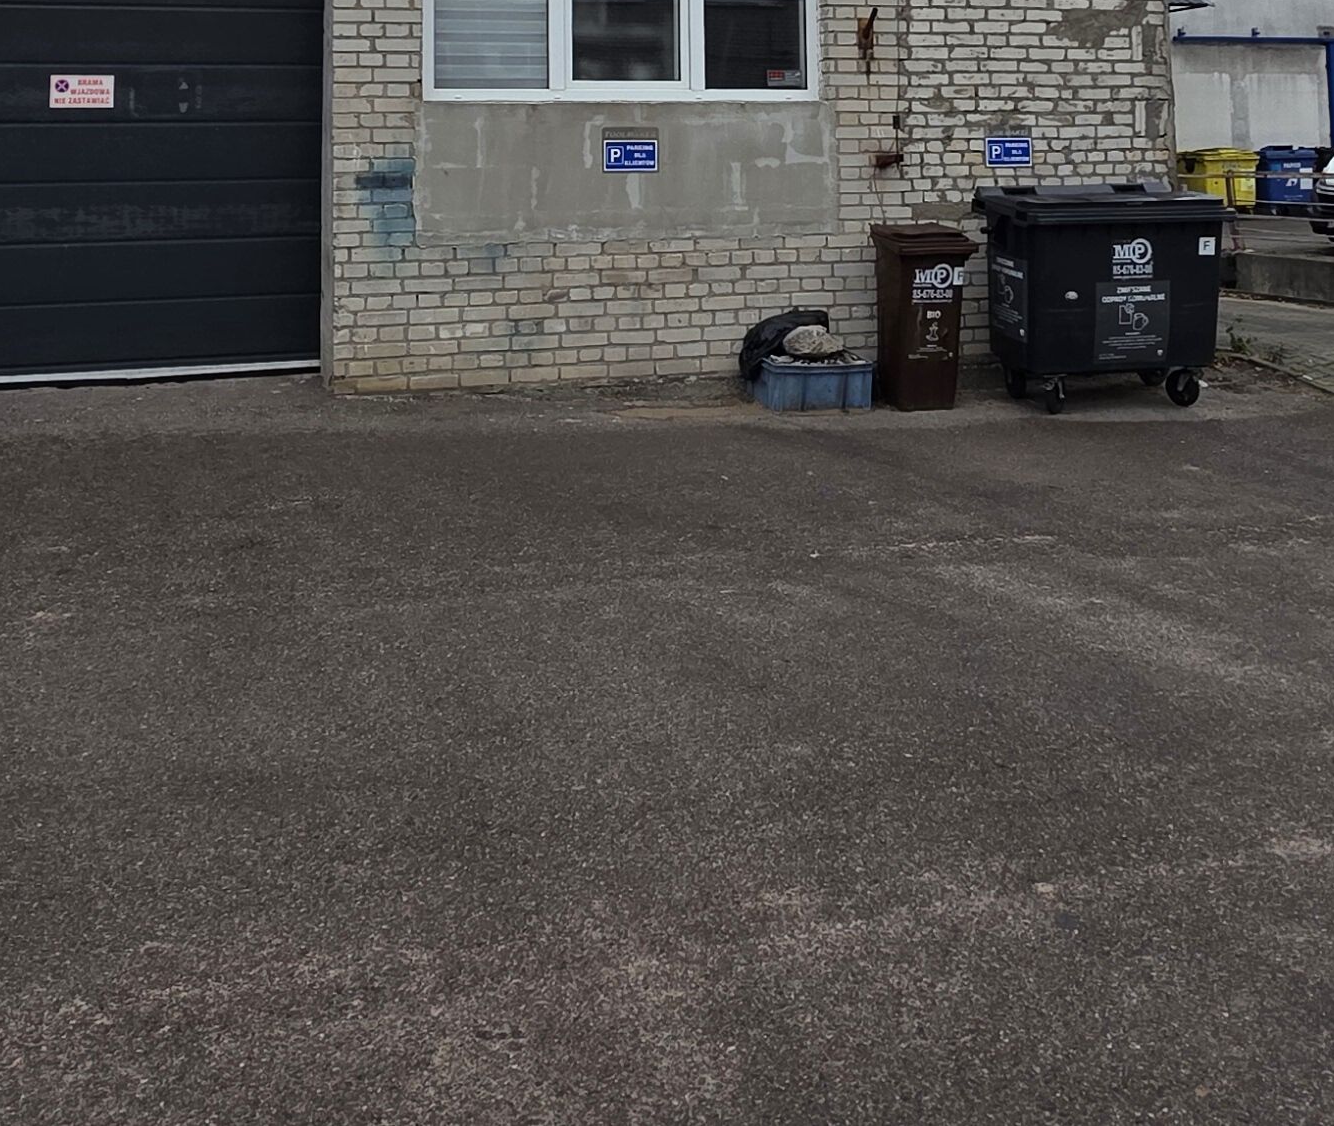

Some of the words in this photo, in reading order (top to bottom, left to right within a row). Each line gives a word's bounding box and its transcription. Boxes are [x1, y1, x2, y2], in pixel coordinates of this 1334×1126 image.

[610, 149, 621, 162] P
[992, 146, 1001, 159] P
[1203, 240, 1211, 250] F
[927, 310, 941, 319] BIO
